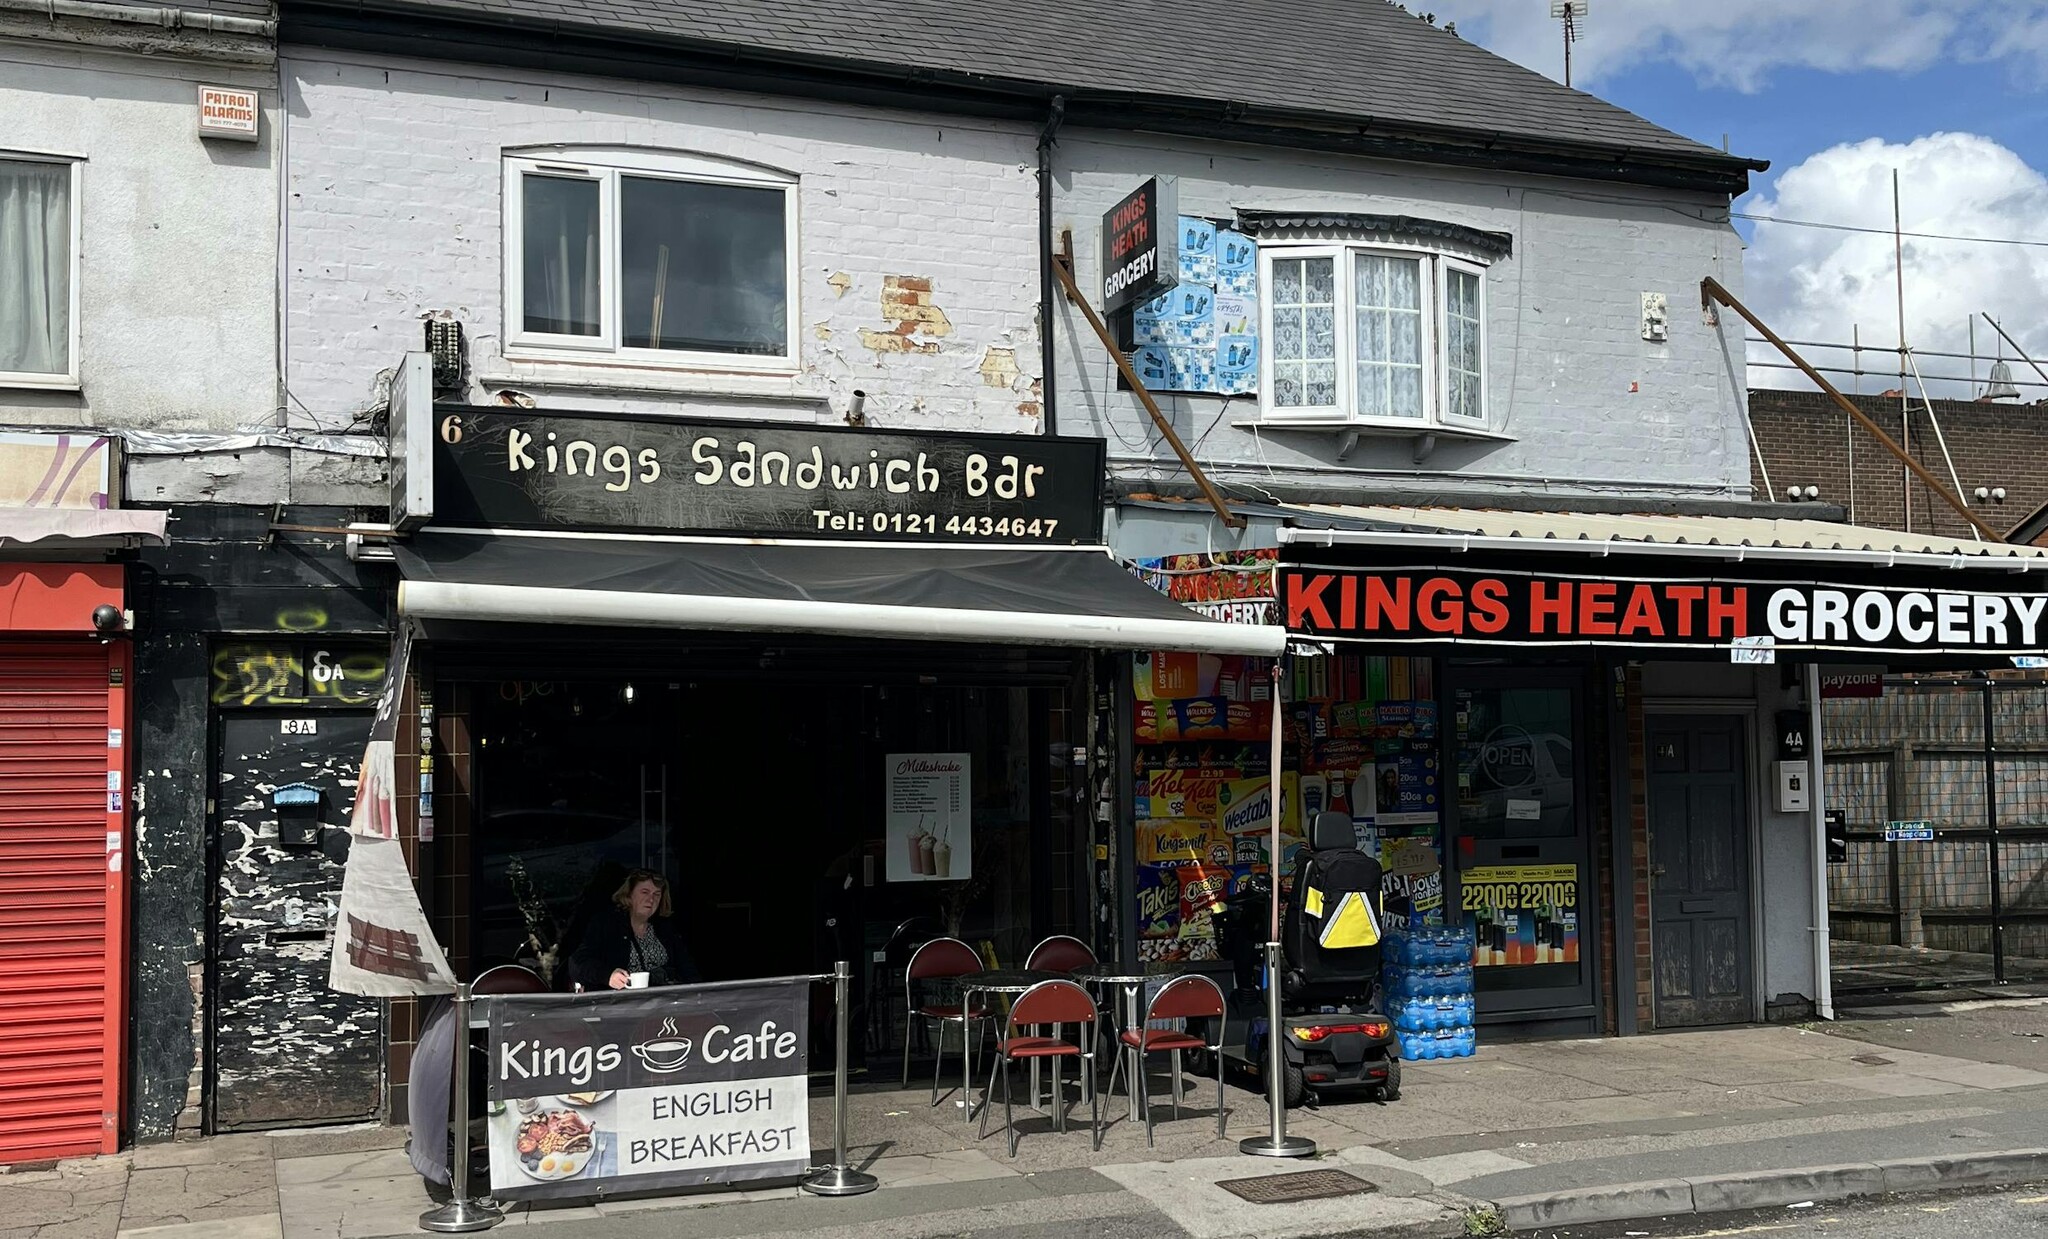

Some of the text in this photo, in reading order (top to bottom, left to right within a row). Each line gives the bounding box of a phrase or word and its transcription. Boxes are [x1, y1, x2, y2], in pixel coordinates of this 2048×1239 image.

[203, 105, 253, 121] ALARMS
[205, 92, 251, 108] PATROL
[1112, 192, 1147, 235] KINGS
[1111, 219, 1148, 261] HEATH
[1105, 246, 1156, 299] GROCERY
[441, 414, 463, 443] 6
[508, 428, 1044, 500] Kings Sandwich Bar
[813, 510, 1058, 538] Tel: 0121 4434647
[1287, 574, 2048, 646] KINGS HEATH GROCERY
[1821, 671, 1878, 690] payzone
[1186, 706, 1217, 717] WALKERS
[1379, 705, 1411, 715] HARIBO
[1785, 731, 1804, 746] 4A
[897, 758, 962, 775] Milkshake
[1485, 747, 1533, 766] OPEN
[1400, 791, 1422, 801] 50GB
[1223, 788, 1286, 832] Weetab
[1155, 831, 1208, 854] Kingsmill
[1236, 852, 1259, 862] BEANZ
[1185, 876, 1223, 900] Cheetos
[1461, 884, 1518, 911] 22000
[1520, 882, 1576, 909] 22000
[500, 1020, 797, 1085] Kings Cafe
[652, 1088, 773, 1120] ENGLISH
[630, 1127, 797, 1164] BREAKFAST
